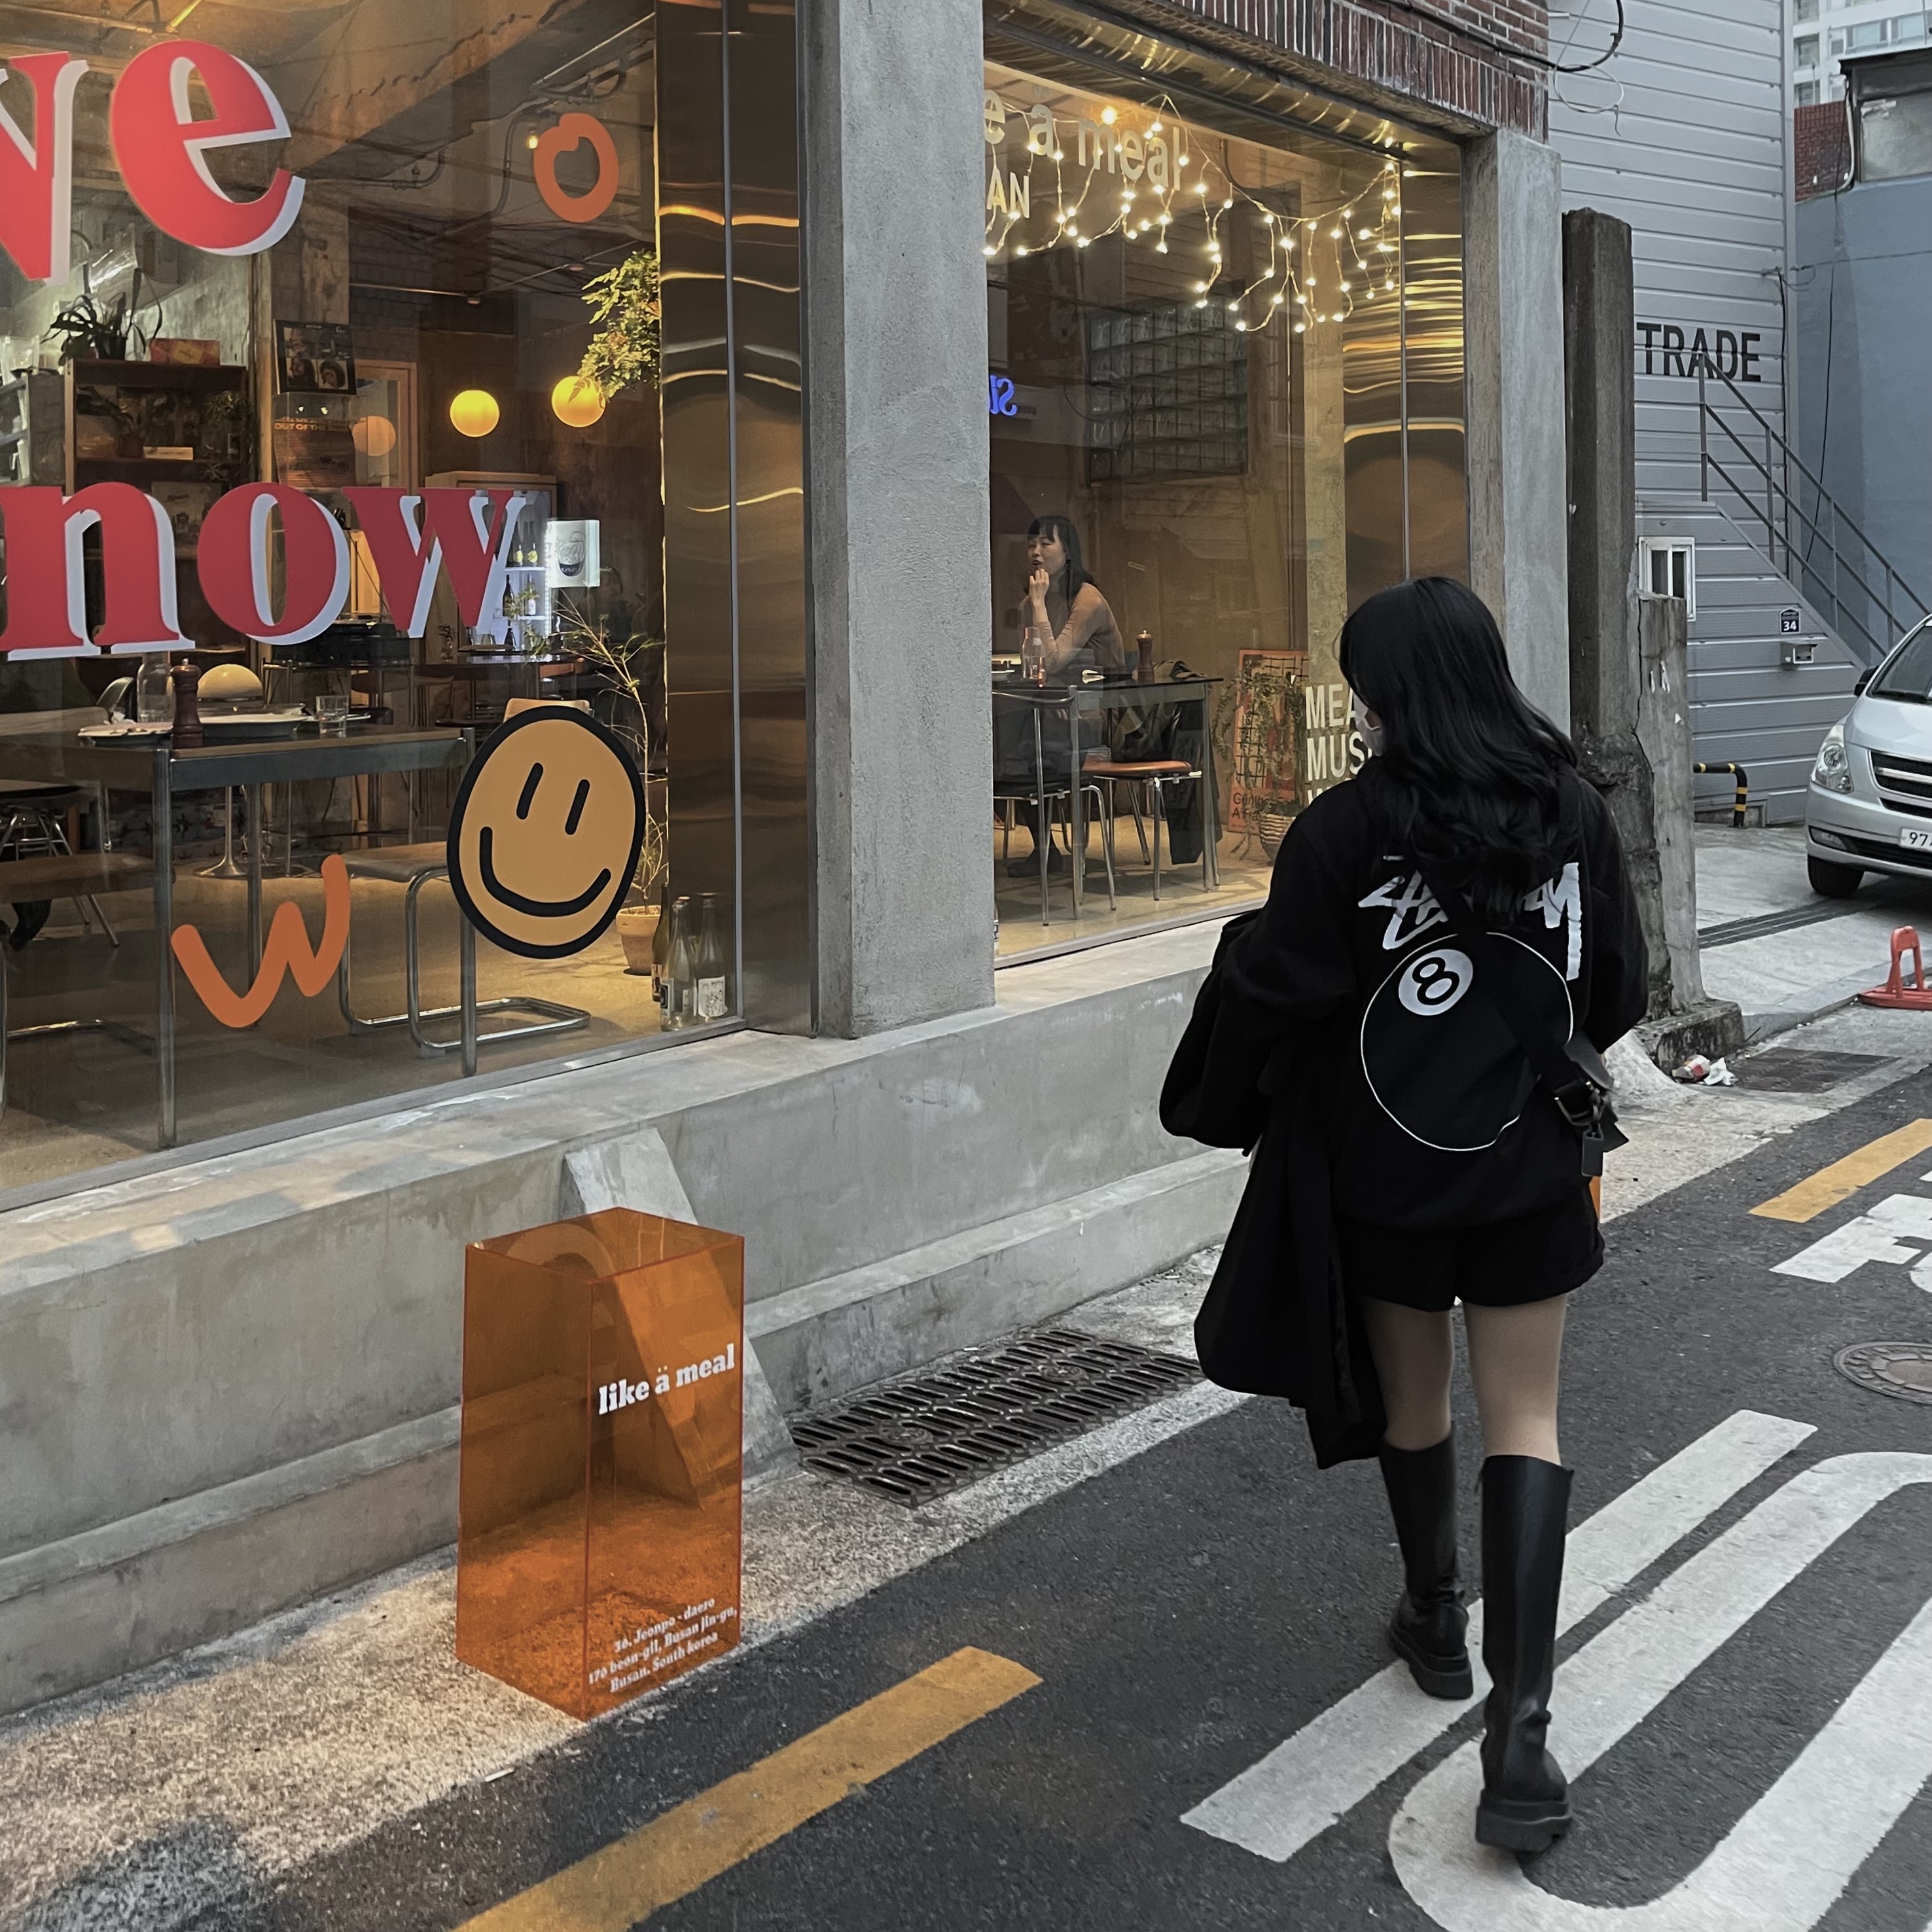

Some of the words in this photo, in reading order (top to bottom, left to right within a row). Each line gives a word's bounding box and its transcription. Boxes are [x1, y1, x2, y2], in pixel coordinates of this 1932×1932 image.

[1079, 118, 1181, 190] meal
[1637, 322, 1762, 382] TRADE
[0, 482, 527, 661] now
[1783, 620, 1797, 632] 34
[1307, 731, 1372, 781] MUS
[1910, 831, 1932, 847] 97
[1412, 957, 1461, 1006] 8
[599, 1378, 650, 1415] like
[675, 1343, 735, 1387] meal
